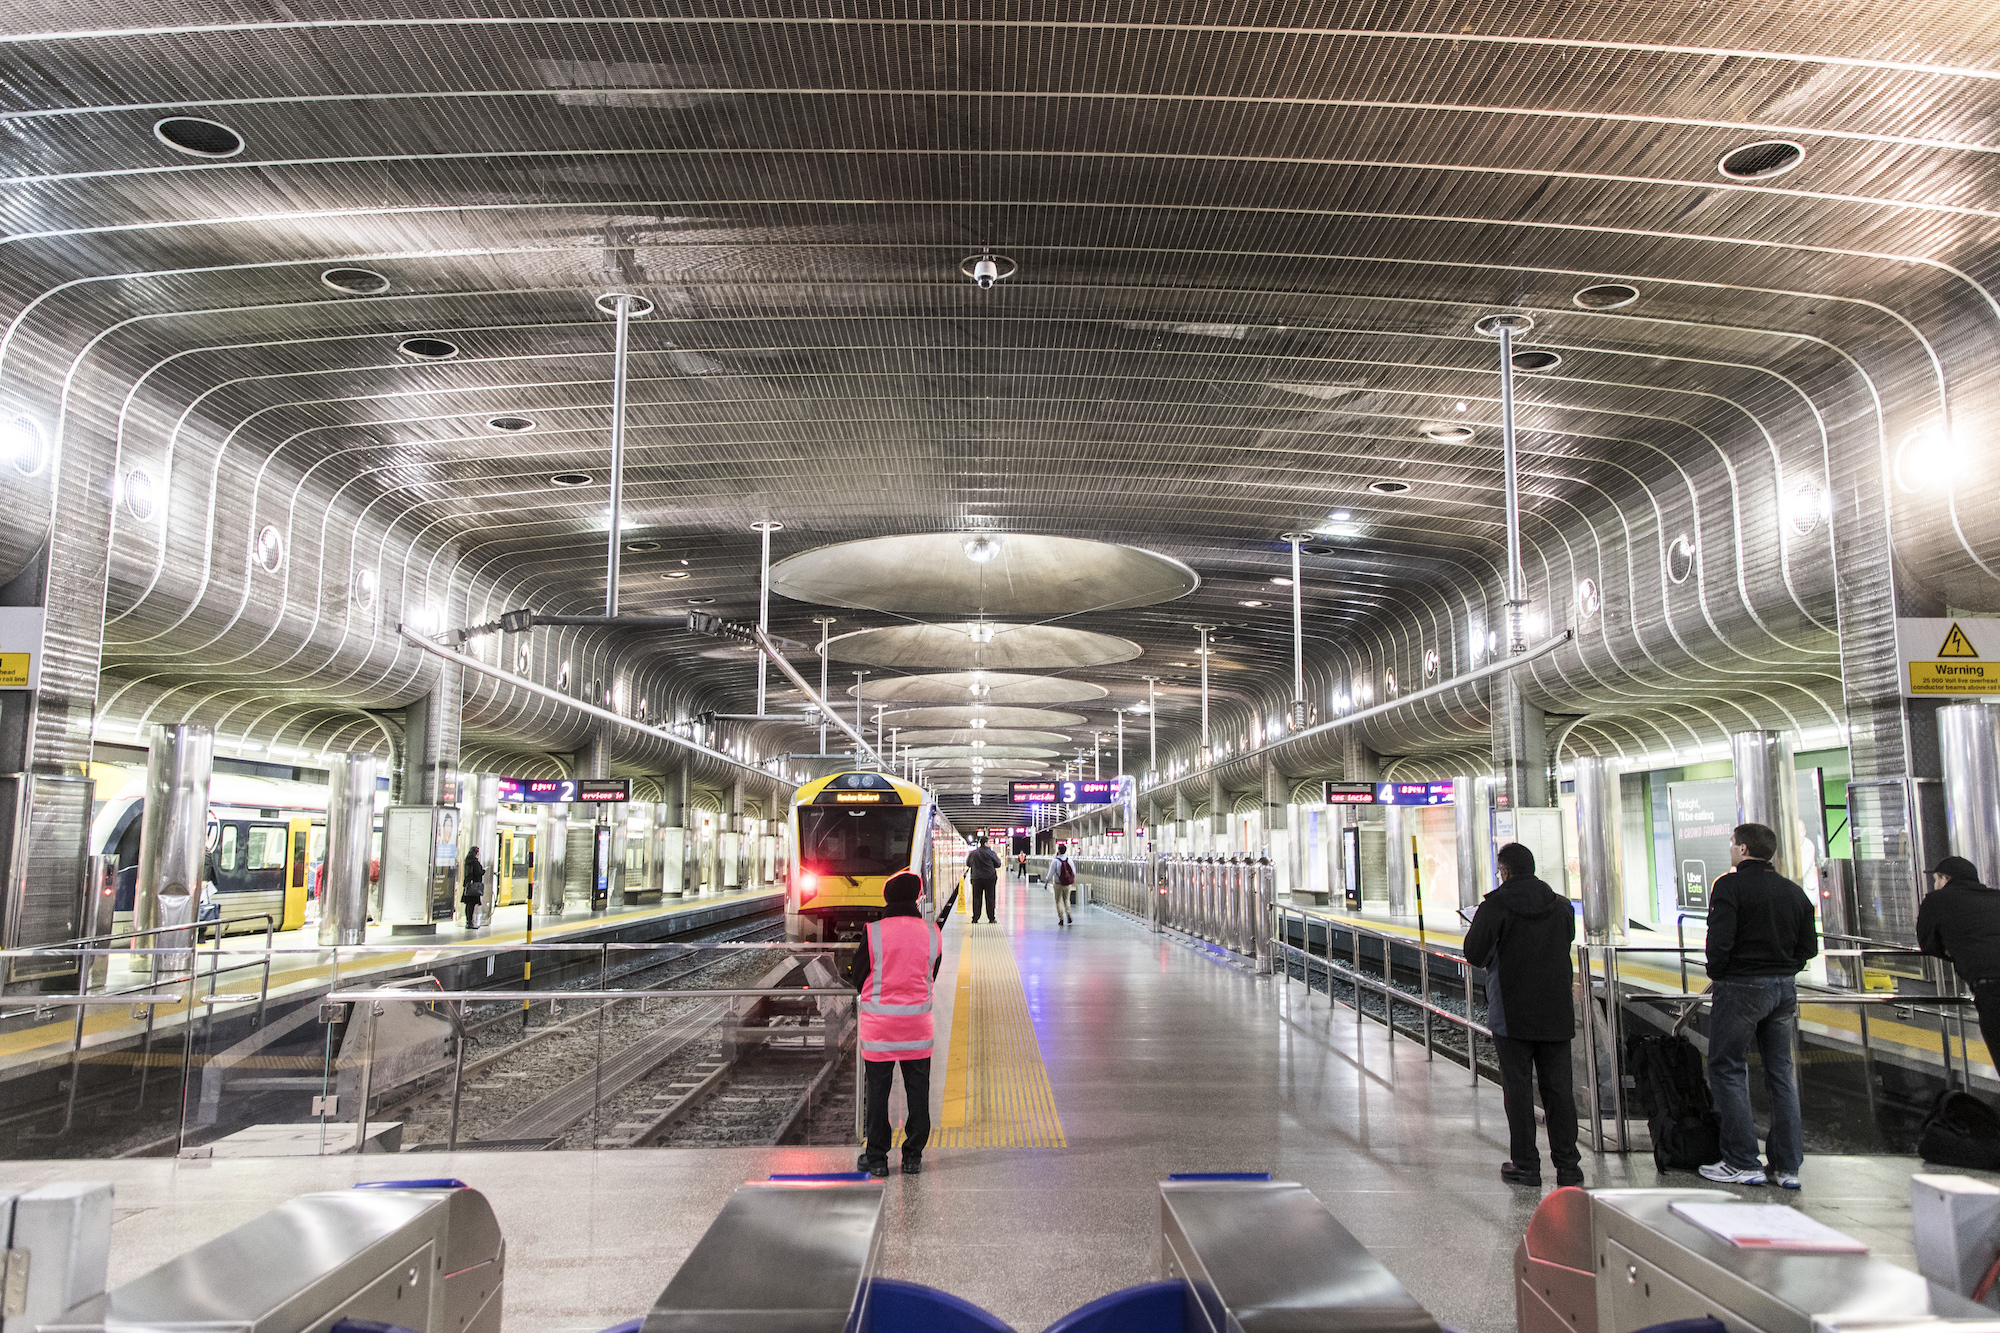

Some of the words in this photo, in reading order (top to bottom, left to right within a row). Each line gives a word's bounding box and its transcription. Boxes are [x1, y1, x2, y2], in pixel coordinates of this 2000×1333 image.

[1935, 665, 1984, 677] Warning
[559, 781, 575, 802] 2
[1062, 782, 1076, 803] 3
[1379, 784, 1395, 804] 4
[1676, 799, 1701, 811] Tonight,
[1685, 811, 1694, 821] be
[1694, 810, 1715, 822] eating
[1679, 828, 1684, 840] A
[1703, 823, 1731, 837] FAVOURITE
[1686, 872, 1702, 883] Uber
[1687, 883, 1703, 894] Eats
